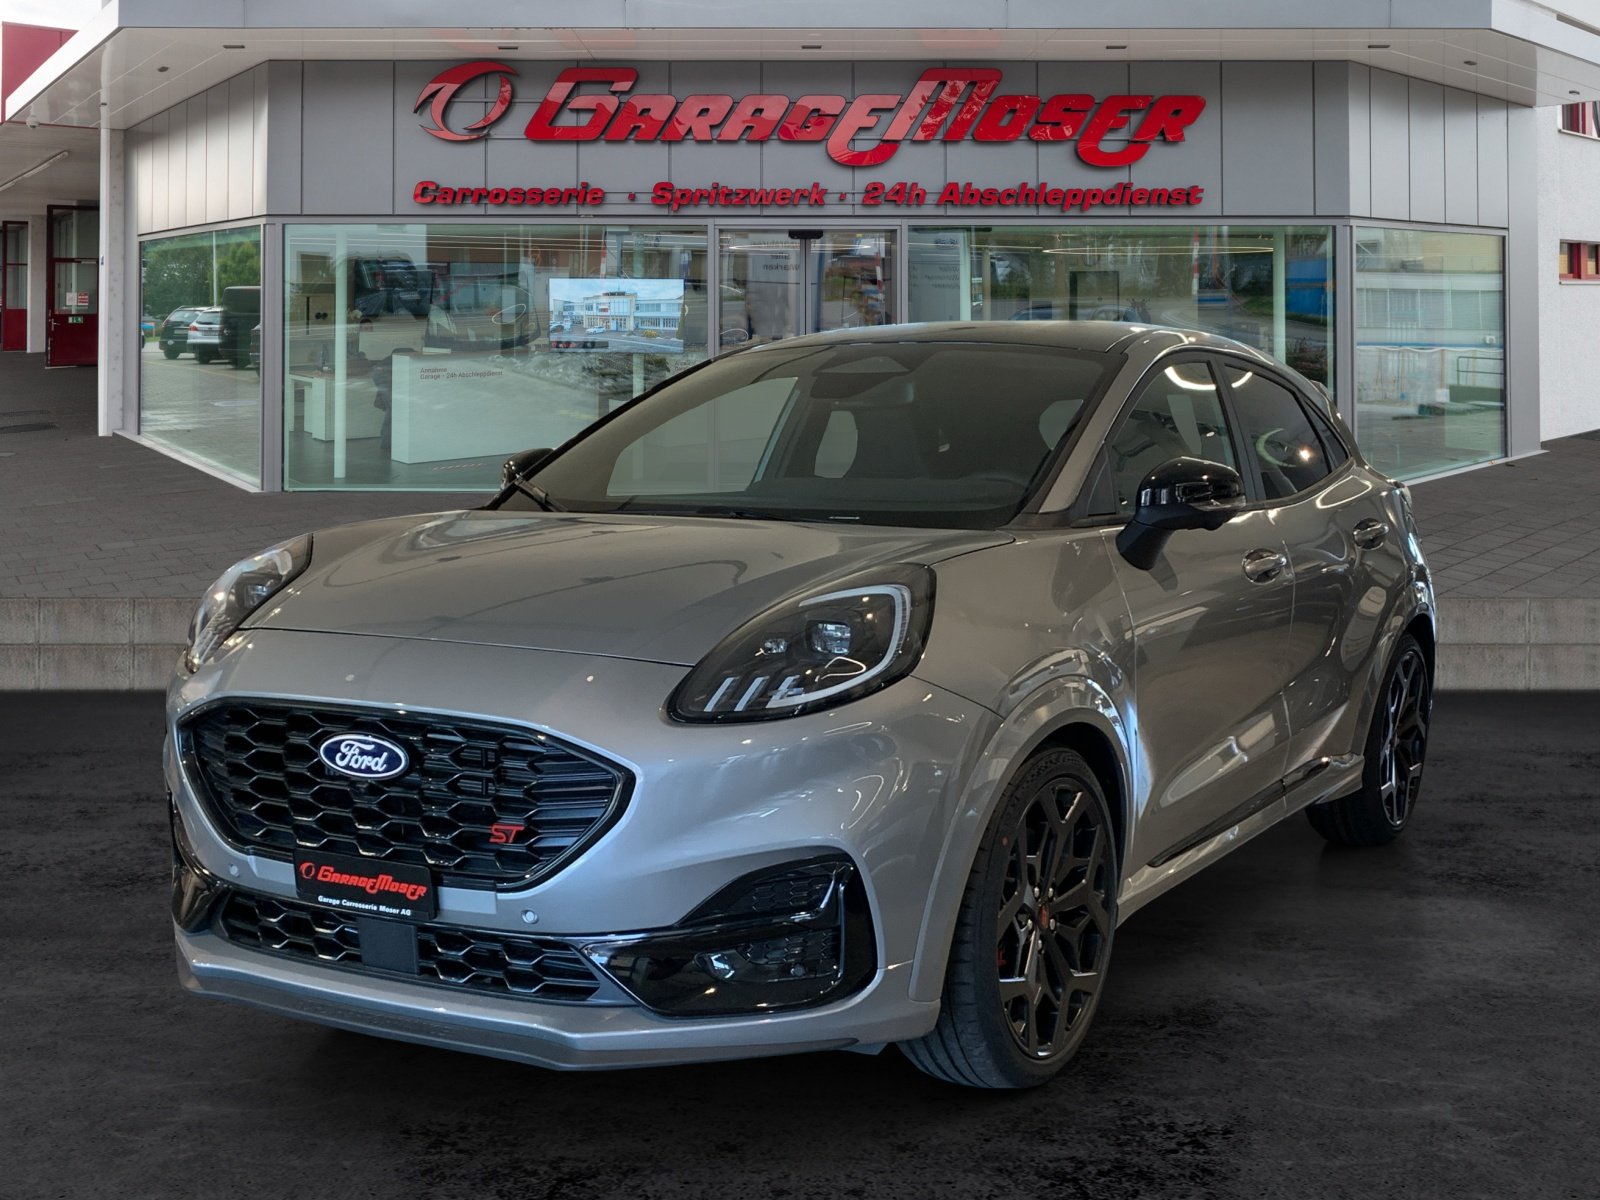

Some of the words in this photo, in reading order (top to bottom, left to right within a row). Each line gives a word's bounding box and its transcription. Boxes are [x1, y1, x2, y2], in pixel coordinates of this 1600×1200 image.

[412, 180, 605, 206] Carrosserie
[650, 181, 827, 211] Spritzwerk
[862, 181, 927, 206] 24h
[936, 181, 1204, 212] Abschleppdienst
[458, 370, 503, 379] Abschleppdienst
[335, 740, 388, 772] Ford
[490, 823, 523, 843] ST
[317, 895, 341, 905] Garage
[341, 899, 378, 911] Carrosserie
[379, 905, 400, 915] Moser
